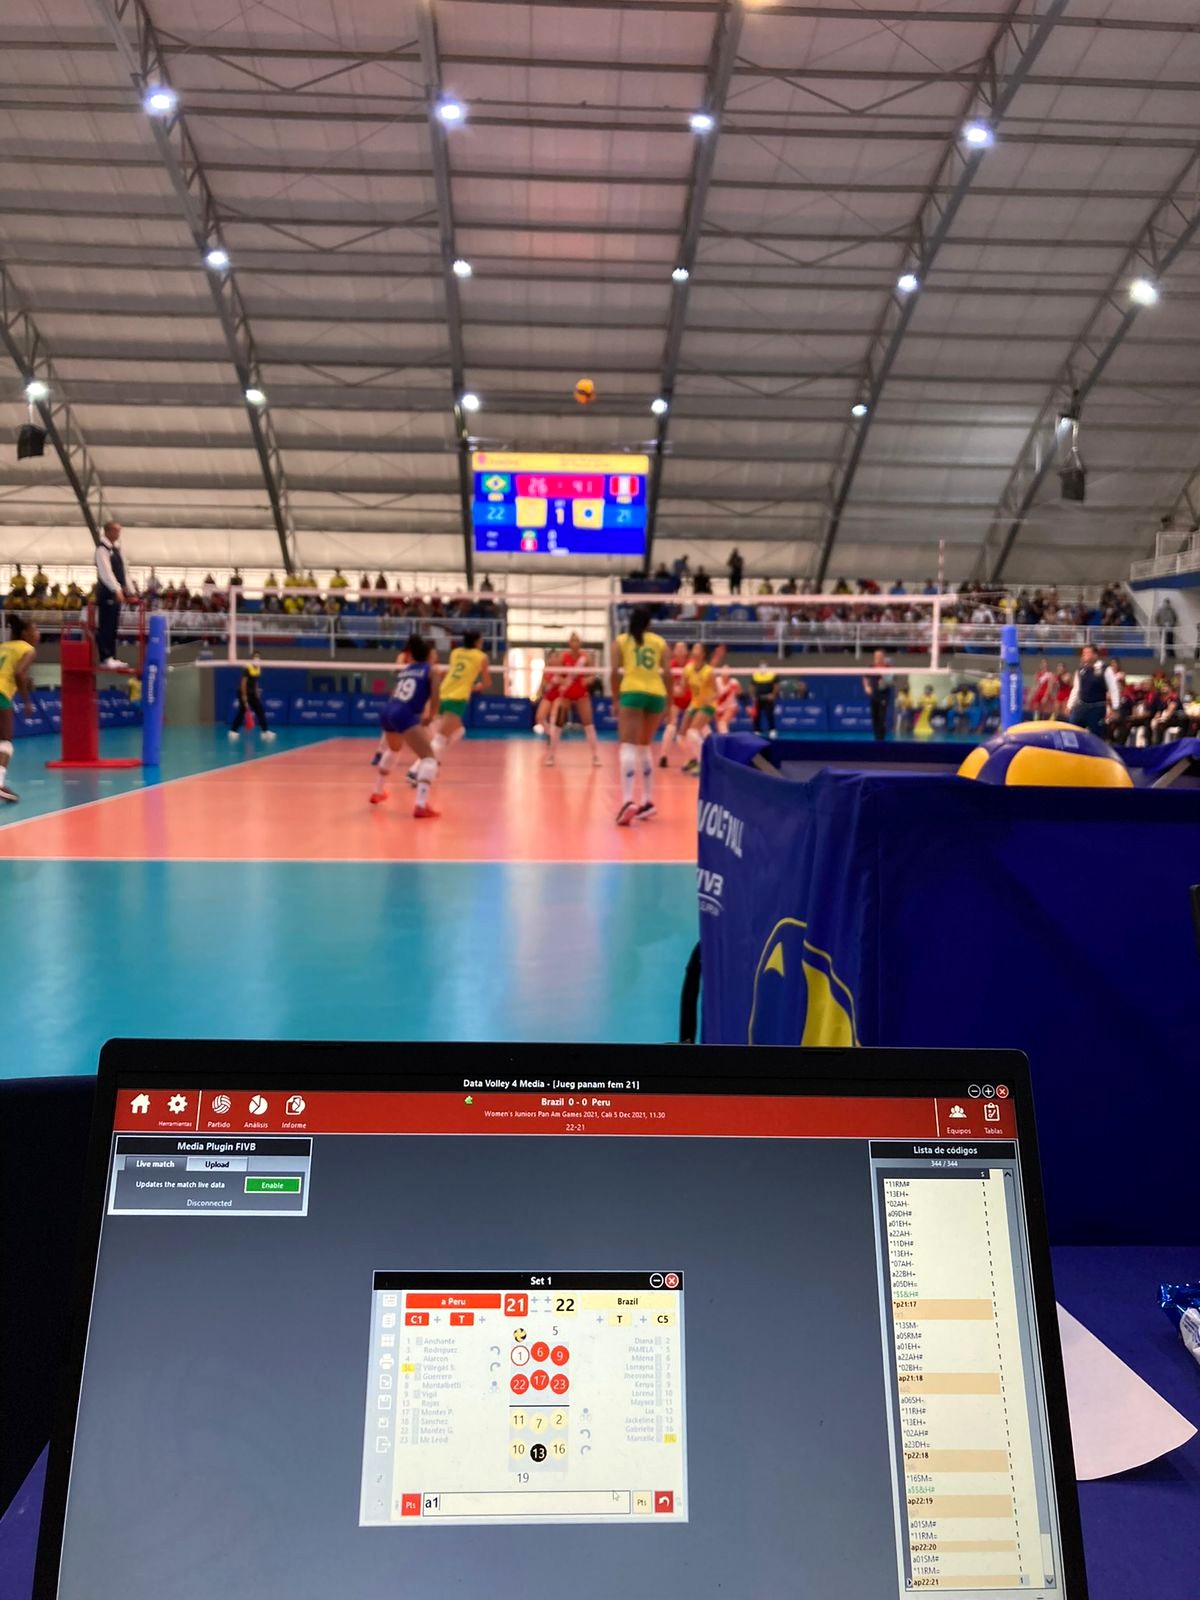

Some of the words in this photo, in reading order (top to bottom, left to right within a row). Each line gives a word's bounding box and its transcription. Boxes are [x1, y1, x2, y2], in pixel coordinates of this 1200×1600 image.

[636, 648, 655, 669] 16
[452, 662, 464, 679] 2
[464, 1080, 482, 1088] Data
[485, 1079, 510, 1090] Volley
[512, 1080, 517, 1088] 4
[520, 1080, 544, 1088] Media
[553, 1080, 575, 1090] [Jueg
[577, 1082, 605, 1090] panam
[608, 1081, 624, 1089] fem
[626, 1081, 639, 1090] 21]
[541, 1098, 564, 1106] Brazil
[632, 1112, 647, 1120] 2021,
[178, 1142, 203, 1150] Media
[207, 1142, 233, 1152] Plugin
[237, 1143, 256, 1151] FIVB
[914, 1146, 932, 1154] Lista
[935, 1146, 944, 1154] de
[947, 1146, 977, 1155] códigos
[205, 1161, 229, 1169] Upload
[136, 1181, 162, 1189] Updates
[187, 1199, 232, 1207] Disconnected
[531, 1277, 544, 1285] Set
[548, 1277, 551, 1285] 1
[507, 1299, 524, 1312] 21
[556, 1299, 574, 1311] 22
[553, 1326, 558, 1335] 5
[537, 1348, 543, 1357] 6
[557, 1351, 563, 1360] 9
[513, 1380, 525, 1389] 22
[534, 1376, 546, 1385] 17
[554, 1380, 565, 1389] 23
[514, 1416, 524, 1424] 11
[536, 1419, 542, 1429] 7
[556, 1416, 562, 1424] 2
[513, 1445, 525, 1454] 10
[533, 1448, 545, 1458] 13
[554, 1445, 565, 1454] 16
[518, 1473, 529, 1483] 19
[426, 1498, 438, 1508] a1
